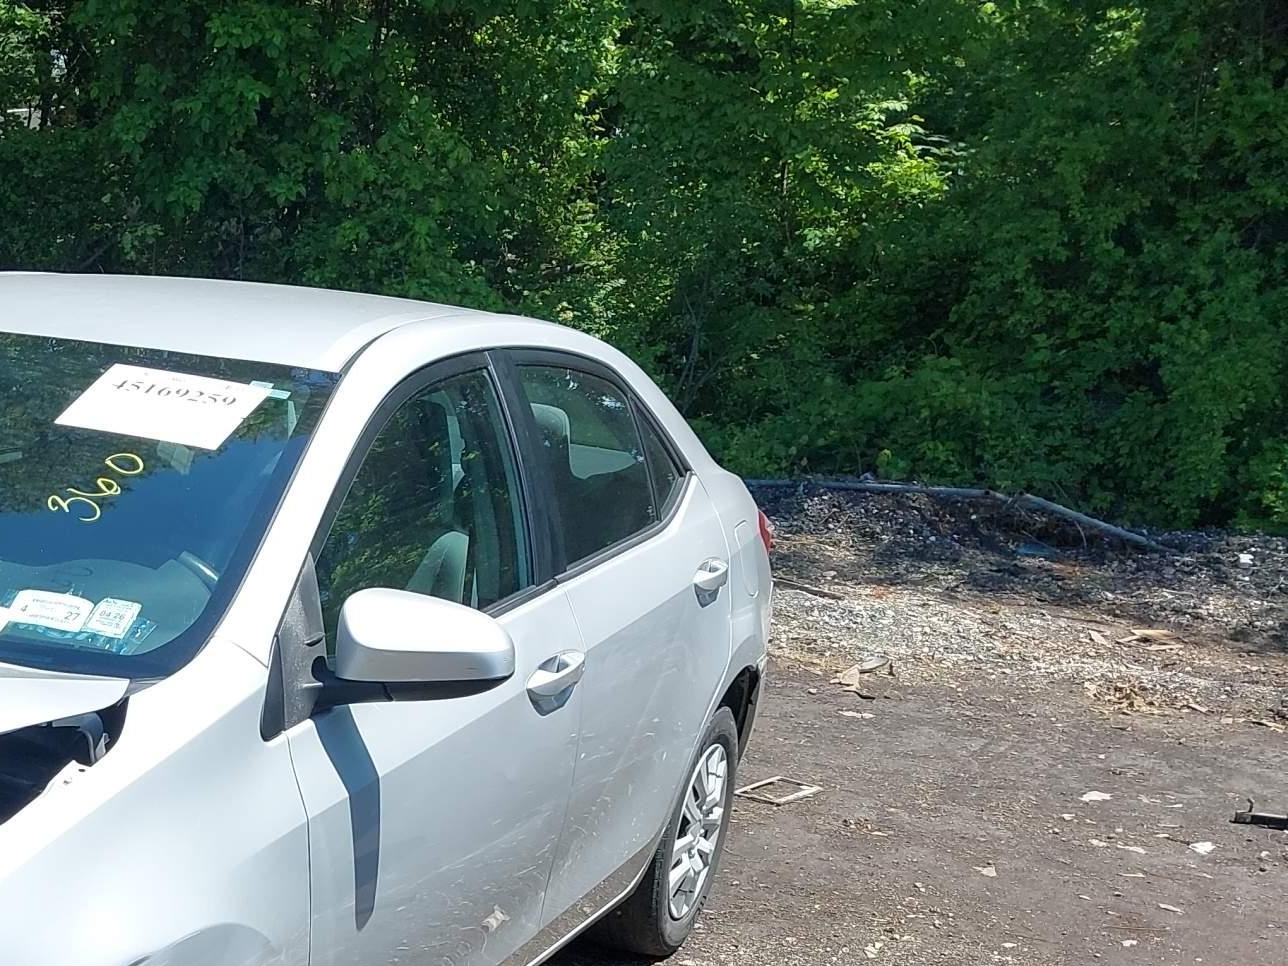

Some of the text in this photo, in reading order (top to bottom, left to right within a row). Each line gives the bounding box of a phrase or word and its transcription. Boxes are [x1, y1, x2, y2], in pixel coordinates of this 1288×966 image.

[112, 379, 237, 405] 45169259
[47, 453, 144, 521] 360
[63, 610, 81, 622] 27
